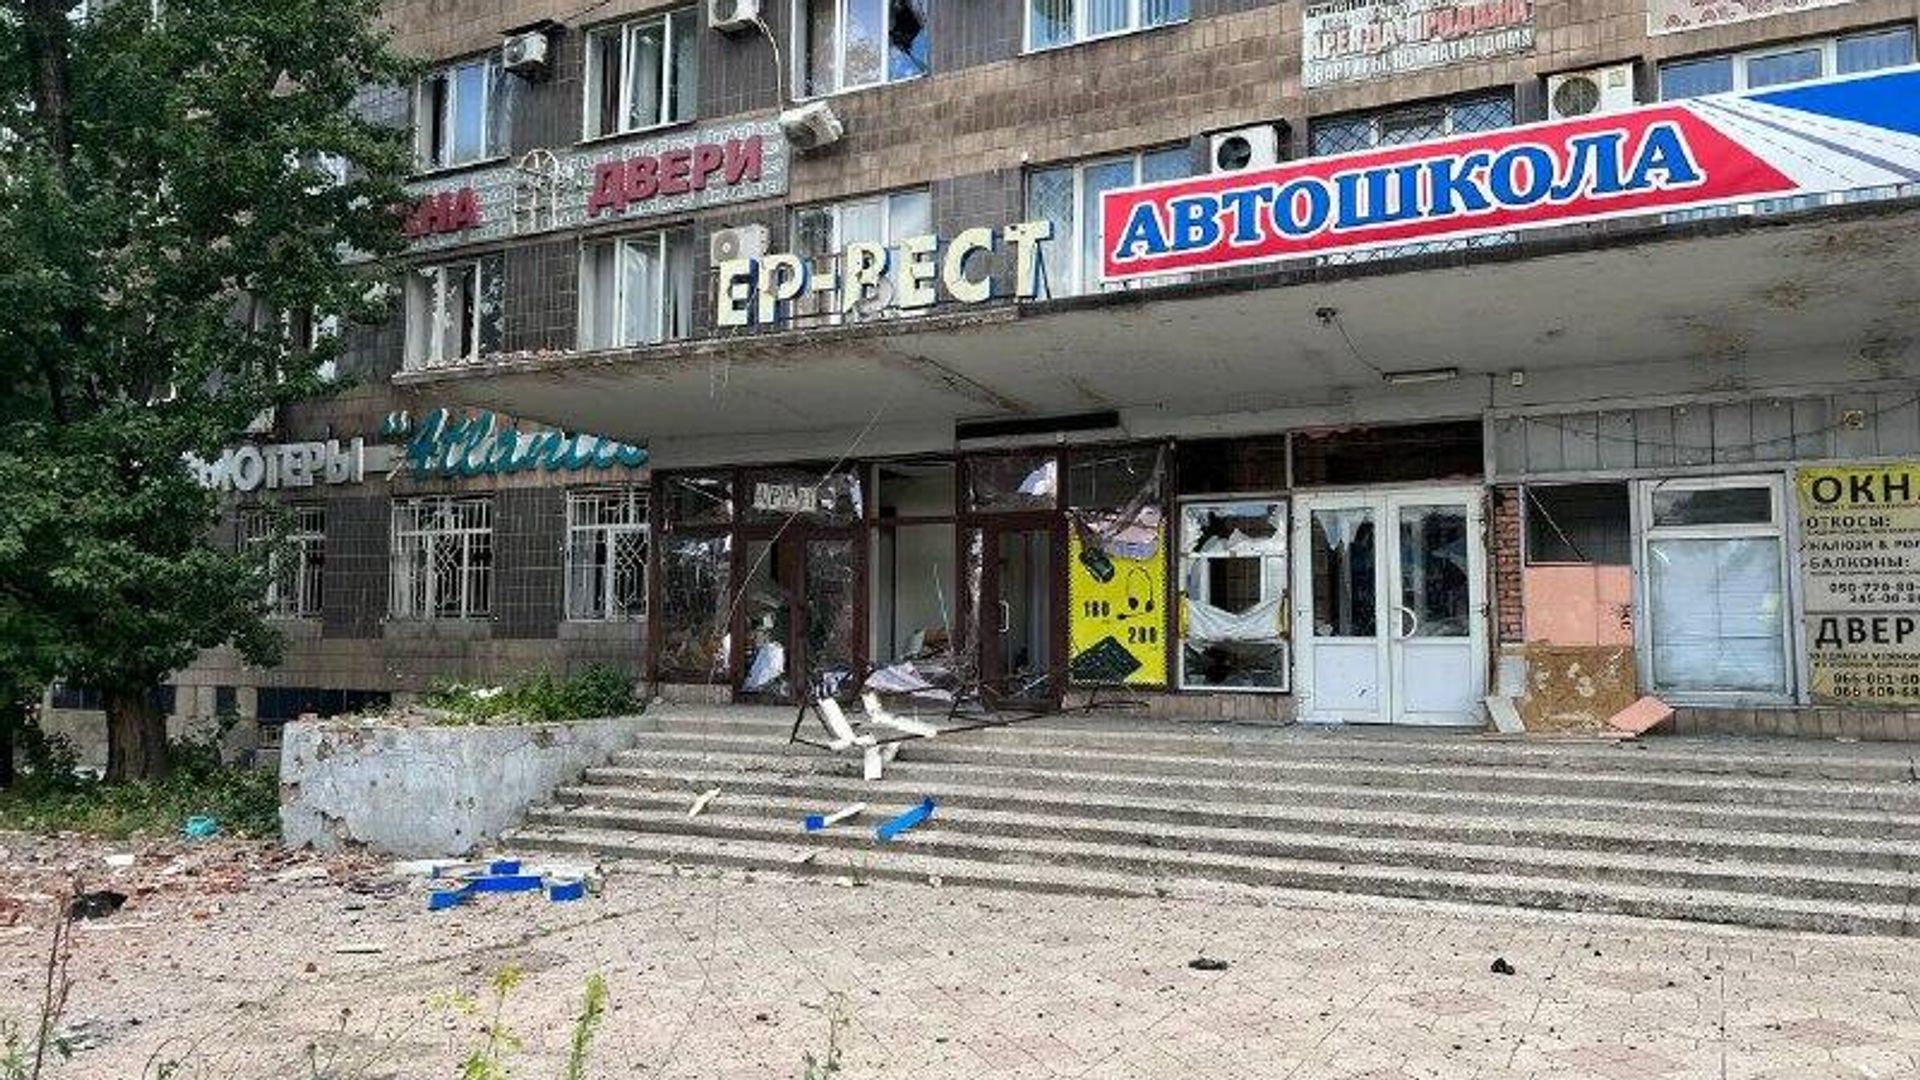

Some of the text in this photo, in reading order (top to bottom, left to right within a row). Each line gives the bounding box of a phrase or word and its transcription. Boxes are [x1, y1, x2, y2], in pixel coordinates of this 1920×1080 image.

[587, 134, 763, 217] ДВЕРИ
[1115, 126, 1700, 259] АВТОШКОЛА
[1811, 473, 1920, 504] ОКН
[1806, 516, 1891, 528] ОТКОСЫ:
[1809, 556, 1910, 570] БАЛКОНЫ:
[1815, 616, 1915, 650] ДВЕР
